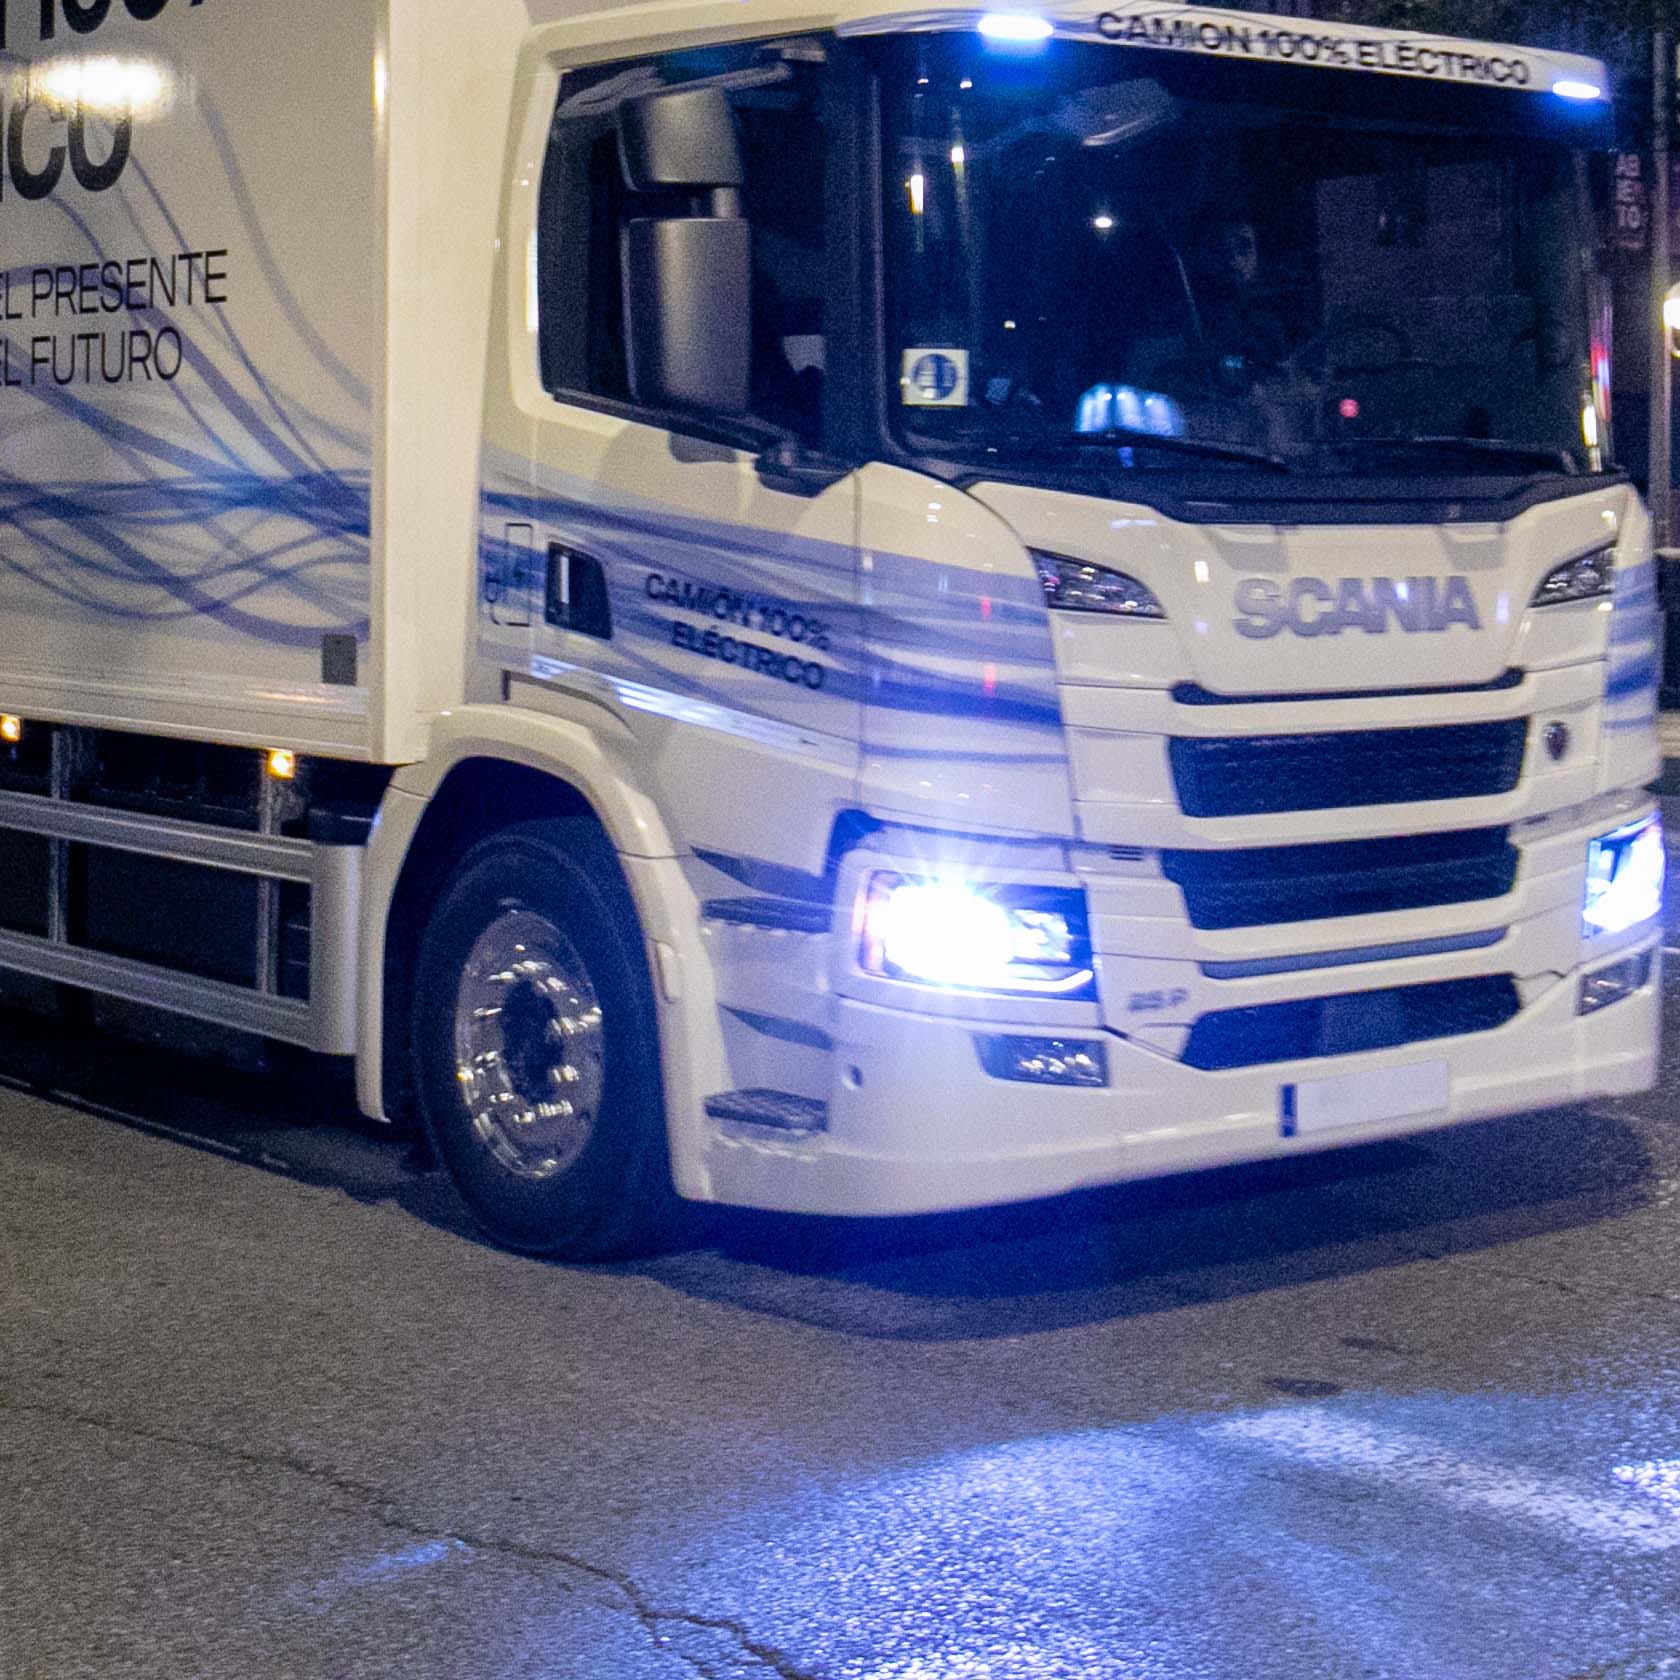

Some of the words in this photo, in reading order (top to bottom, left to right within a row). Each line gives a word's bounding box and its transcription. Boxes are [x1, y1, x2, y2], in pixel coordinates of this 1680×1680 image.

[1257, 28, 1350, 66] 100%
[31, 249, 228, 318] PRESENTE
[31, 325, 184, 386] FUTURO
[1231, 576, 1484, 640] SCANIA
